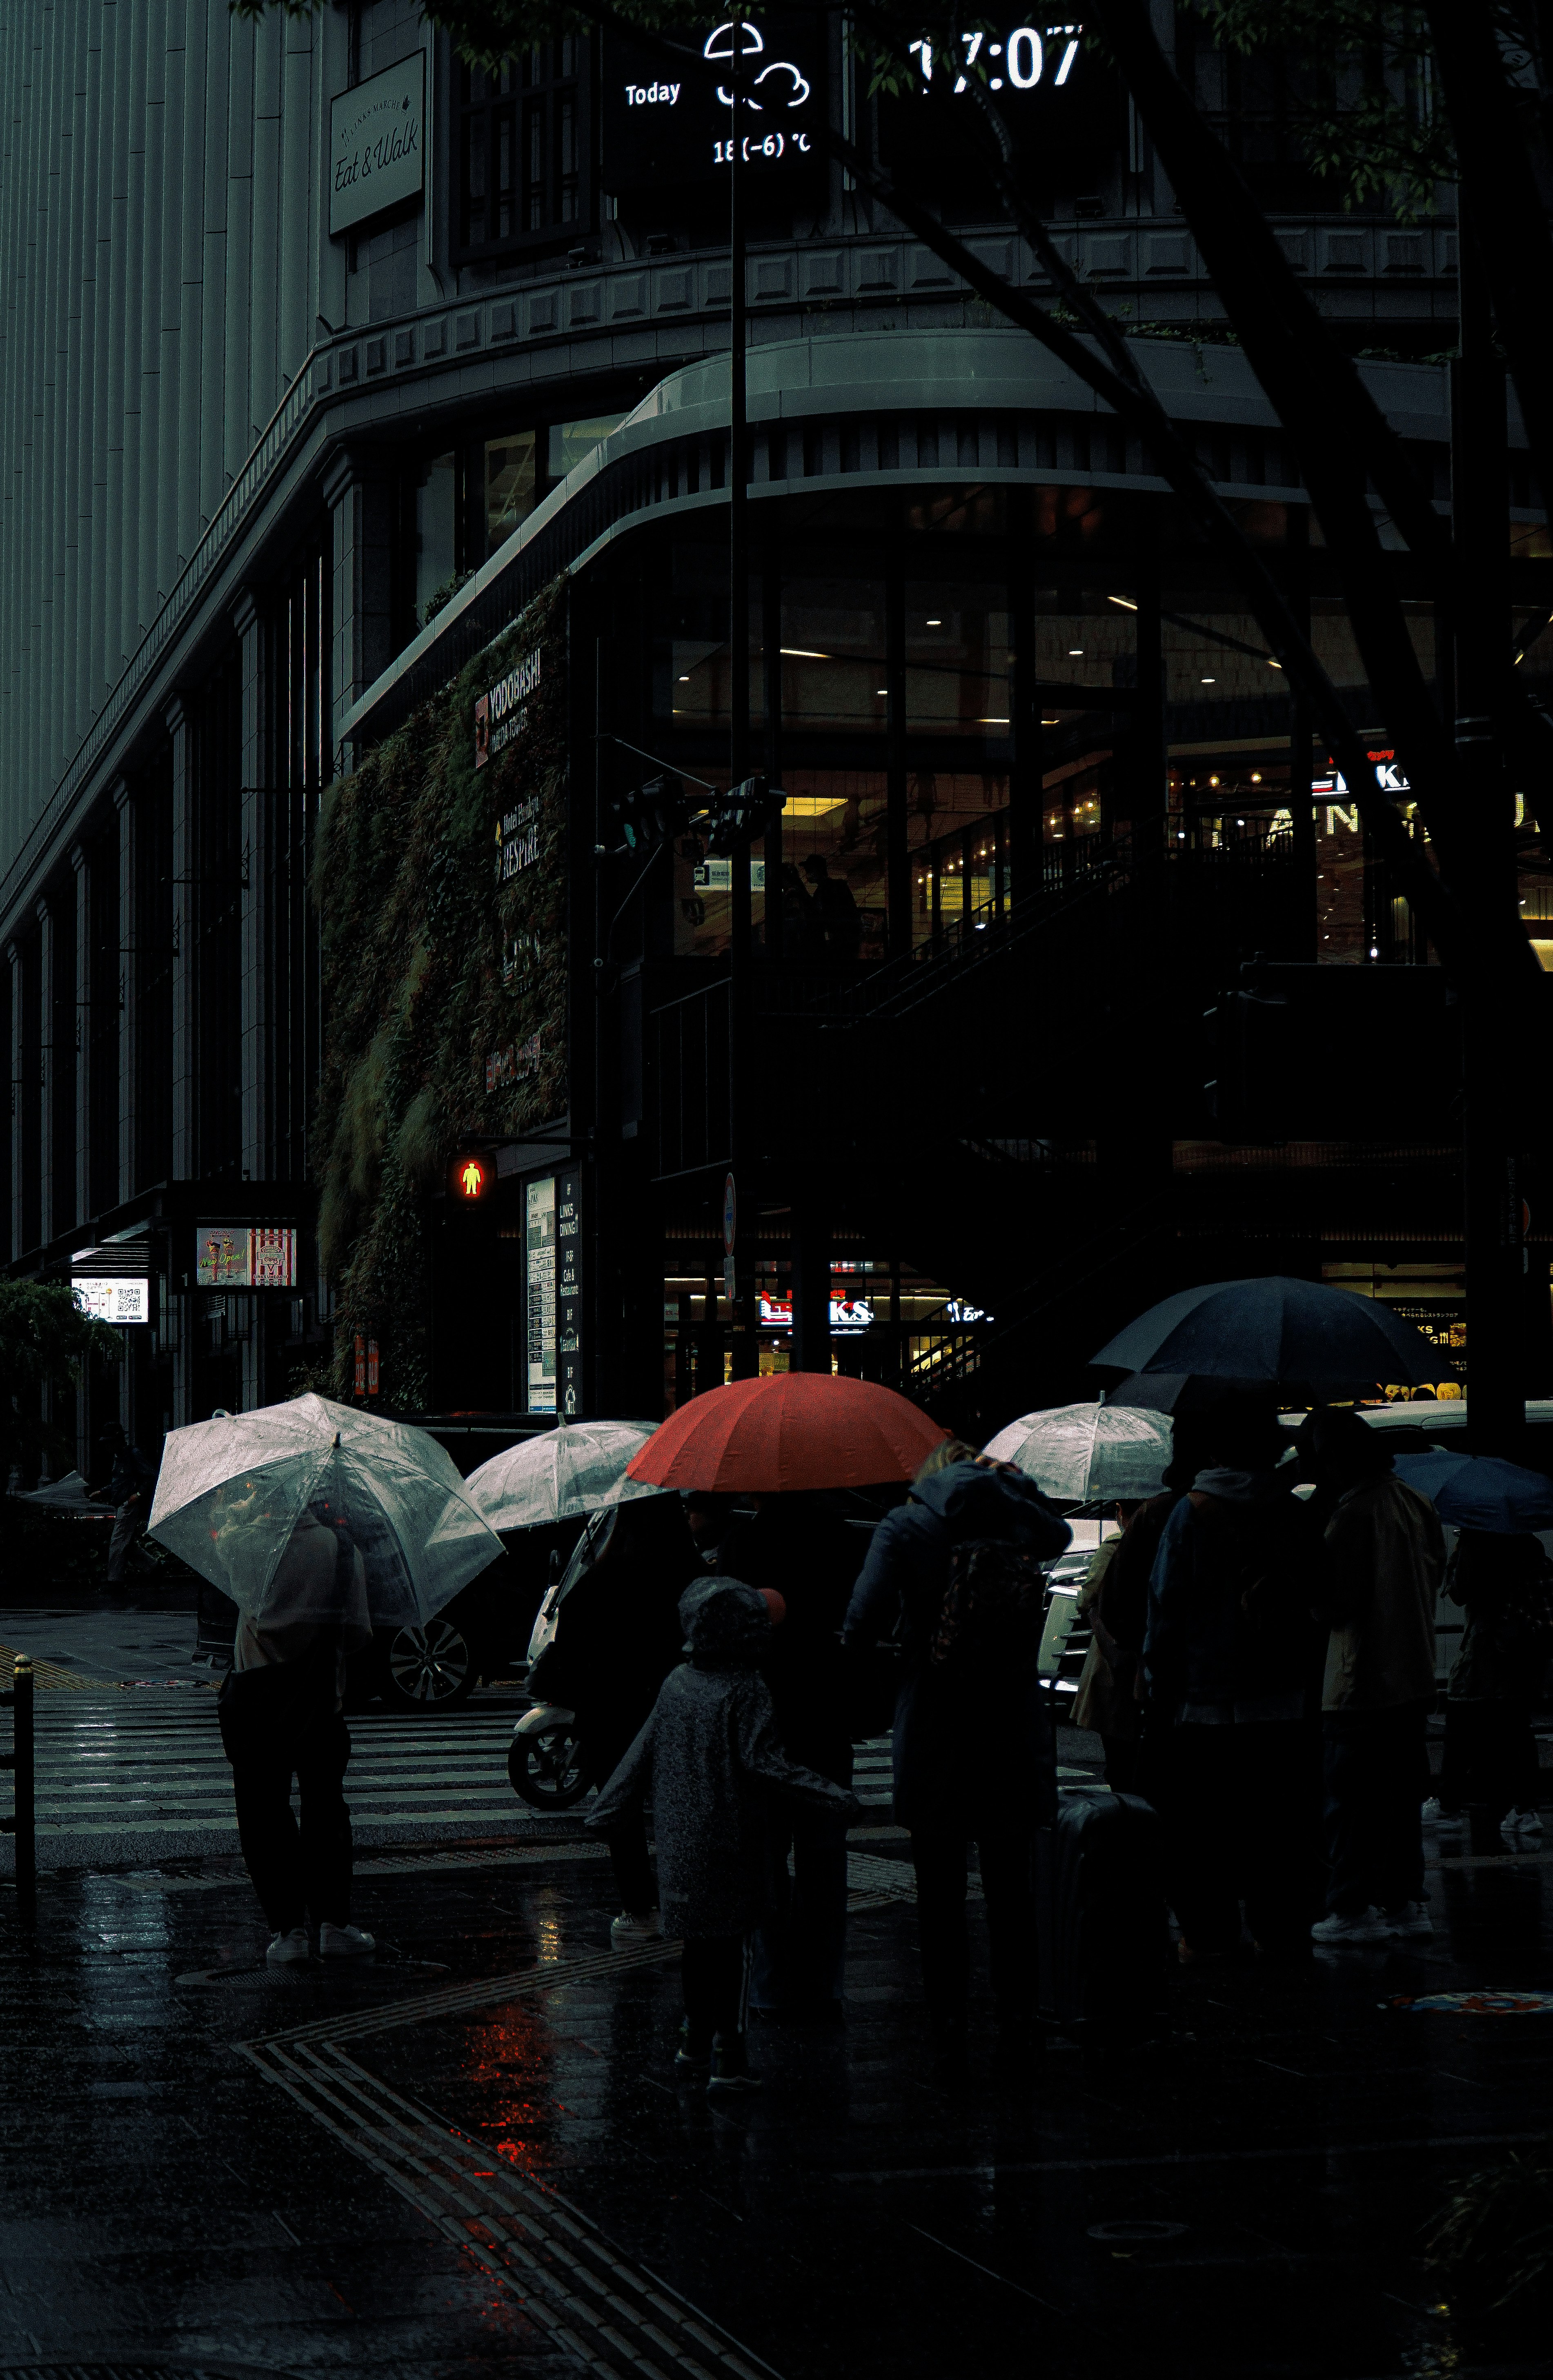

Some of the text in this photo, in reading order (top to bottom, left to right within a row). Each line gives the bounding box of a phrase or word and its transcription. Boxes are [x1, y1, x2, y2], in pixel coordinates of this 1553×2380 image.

[909, 23, 1084, 95] 17:07
[625, 81, 681, 105] Today
[334, 117, 418, 192] Eat & Walk
[742, 133, 784, 162] (-6)
[490, 647, 540, 724] YODOBASHI
[503, 806, 517, 836] Hotel
[503, 825, 539, 881] RESPIRE
[560, 1203, 573, 1219] LINKS
[560, 1221, 575, 1237] DINING
[181, 1273, 188, 1286] 1
